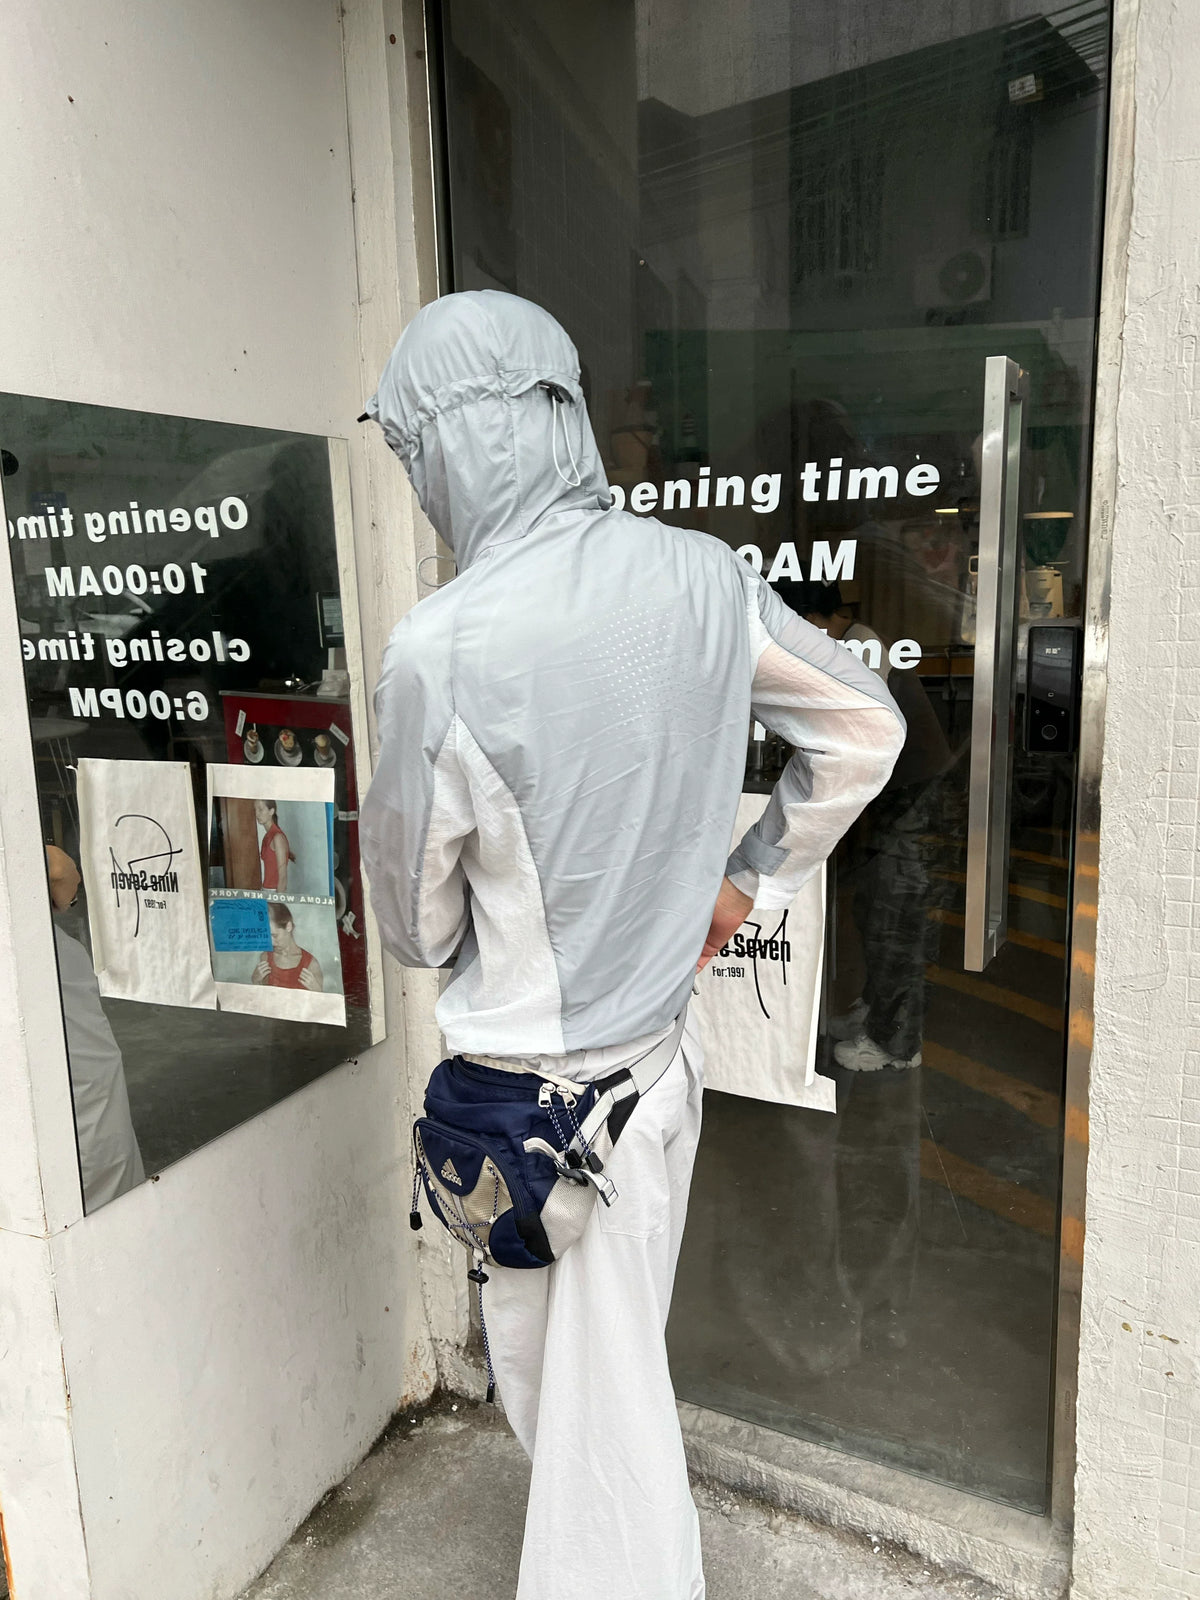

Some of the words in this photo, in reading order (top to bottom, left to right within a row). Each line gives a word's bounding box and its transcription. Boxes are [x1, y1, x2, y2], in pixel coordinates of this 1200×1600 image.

[608, 466, 782, 514] pening
[800, 457, 941, 502] time
[733, 932, 791, 963] Seven
[711, 965, 745, 979] For:1997
